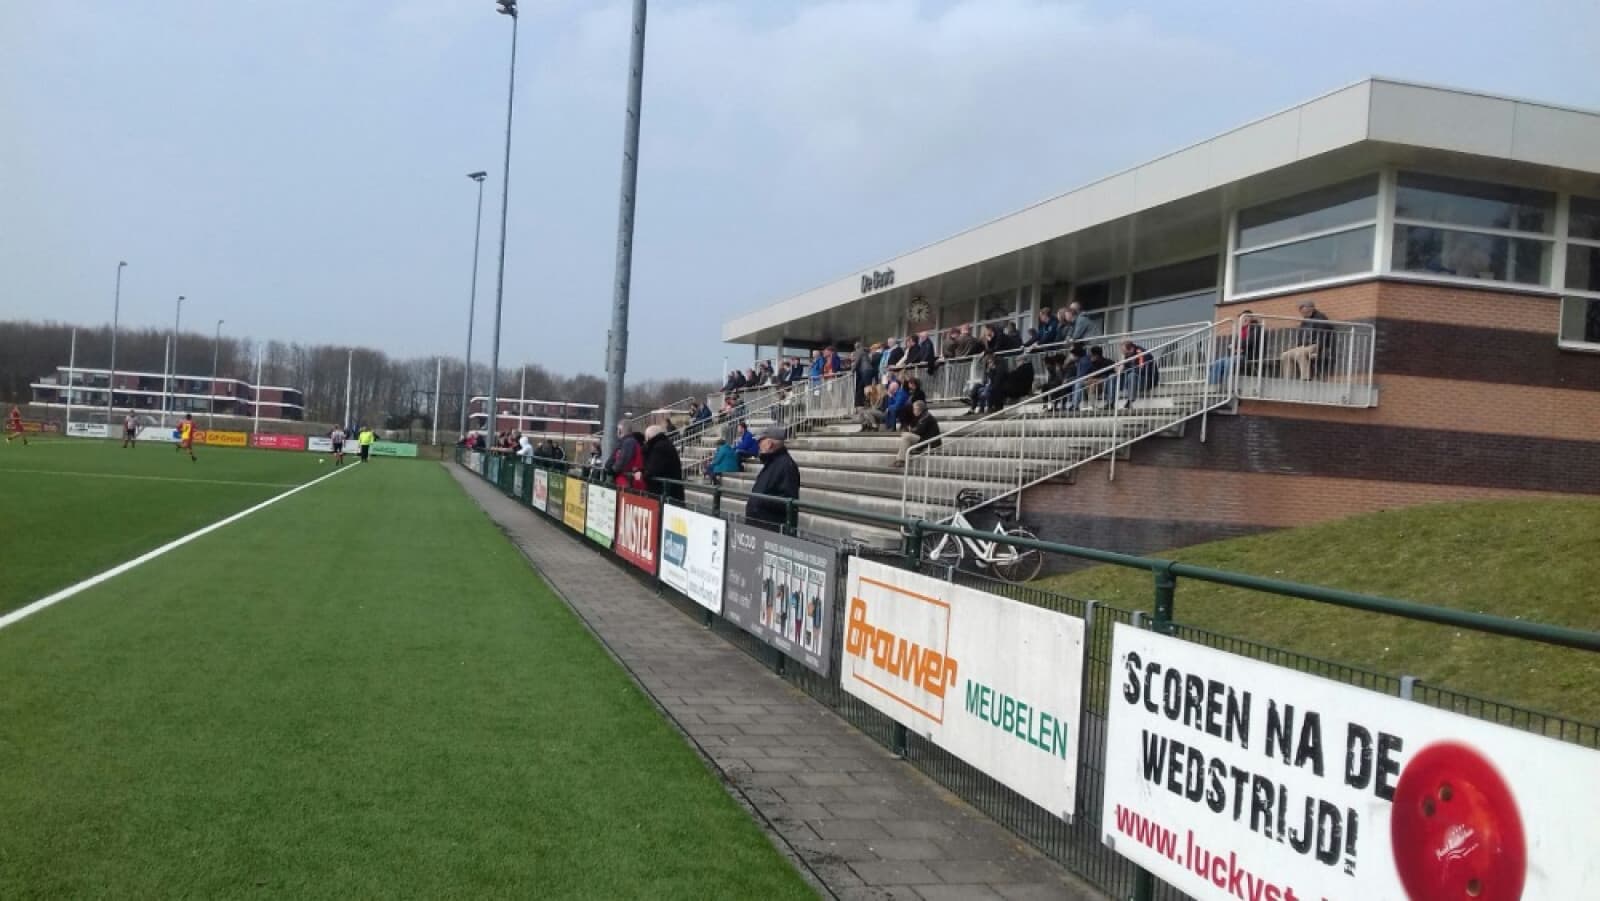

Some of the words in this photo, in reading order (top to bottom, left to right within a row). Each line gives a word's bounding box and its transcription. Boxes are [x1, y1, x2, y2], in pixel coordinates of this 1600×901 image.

[616, 495, 654, 561] AMSTEL
[845, 596, 958, 699] Brouwer
[965, 679, 1068, 761] MEUBELEN
[1122, 650, 1252, 750] SCOREN
[1265, 698, 1325, 777] NA
[1345, 722, 1405, 802] DE
[1113, 804, 1329, 901] www.luckys
[1141, 729, 1359, 877] WEDSTRIJD!
